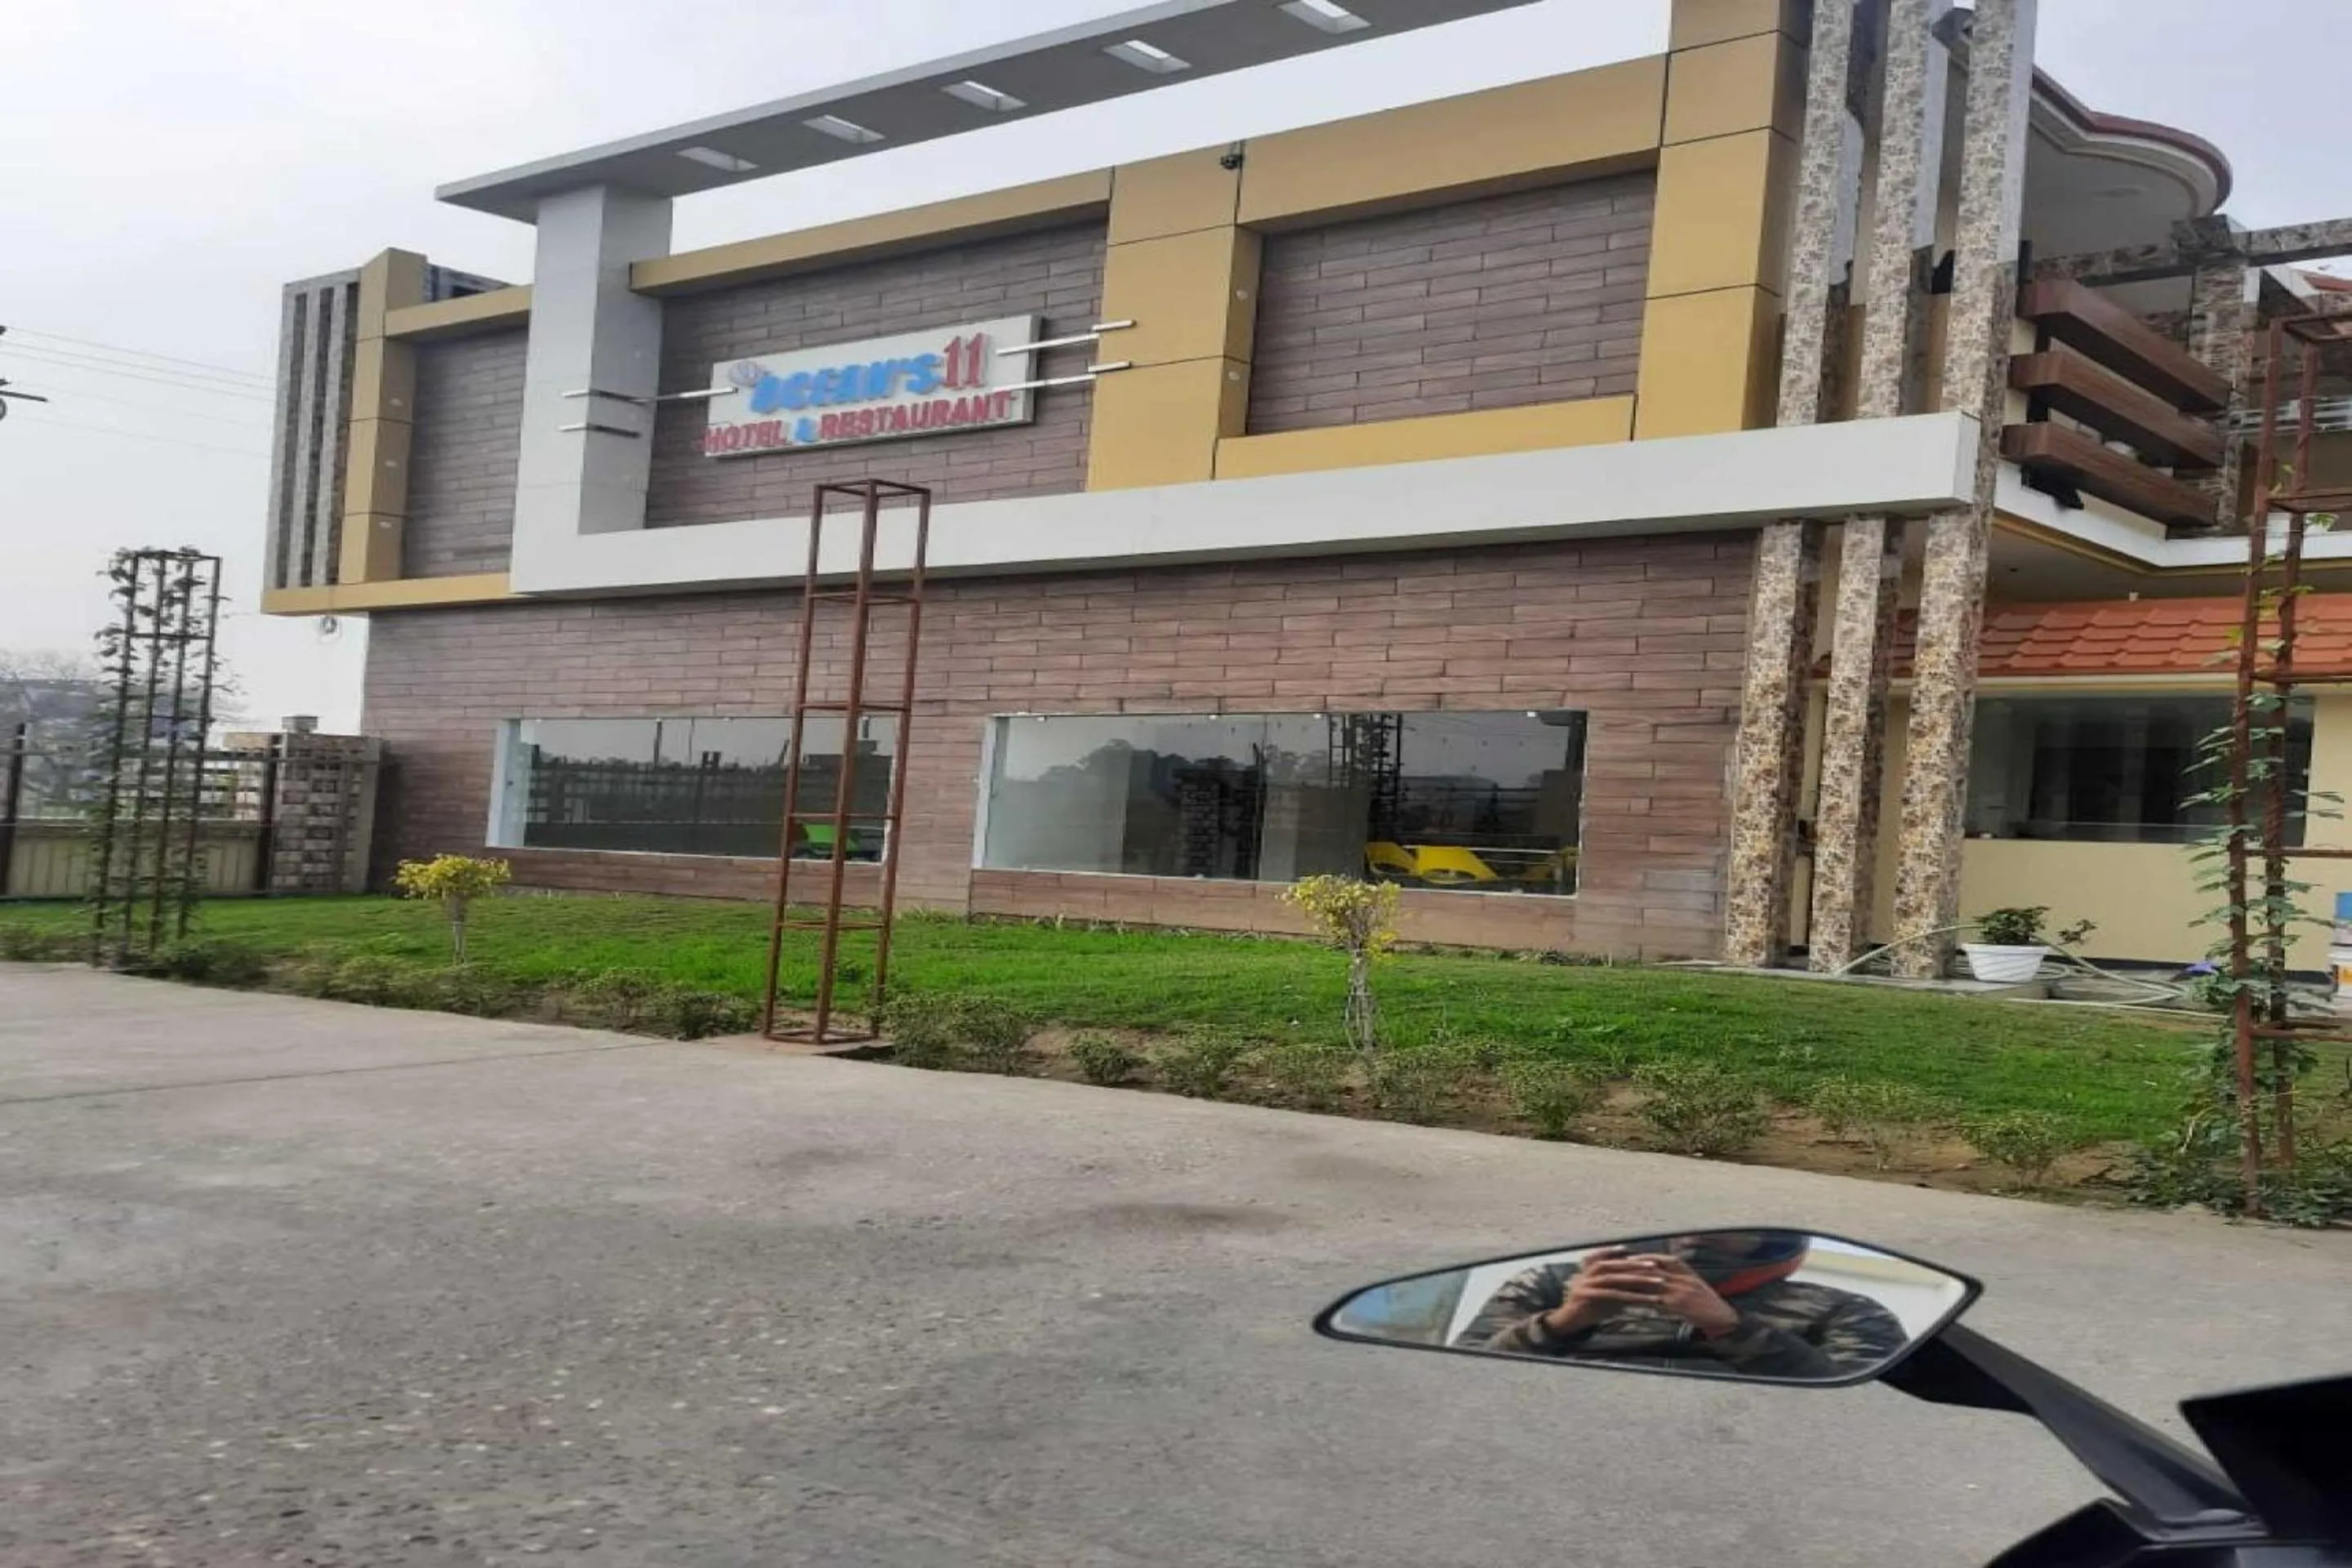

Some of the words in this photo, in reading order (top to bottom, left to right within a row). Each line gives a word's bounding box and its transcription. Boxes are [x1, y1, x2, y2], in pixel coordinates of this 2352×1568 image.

[942, 332, 987, 390] 11
[704, 421, 787, 453] HOTEL
[820, 391, 1015, 439] RESTAURANT
